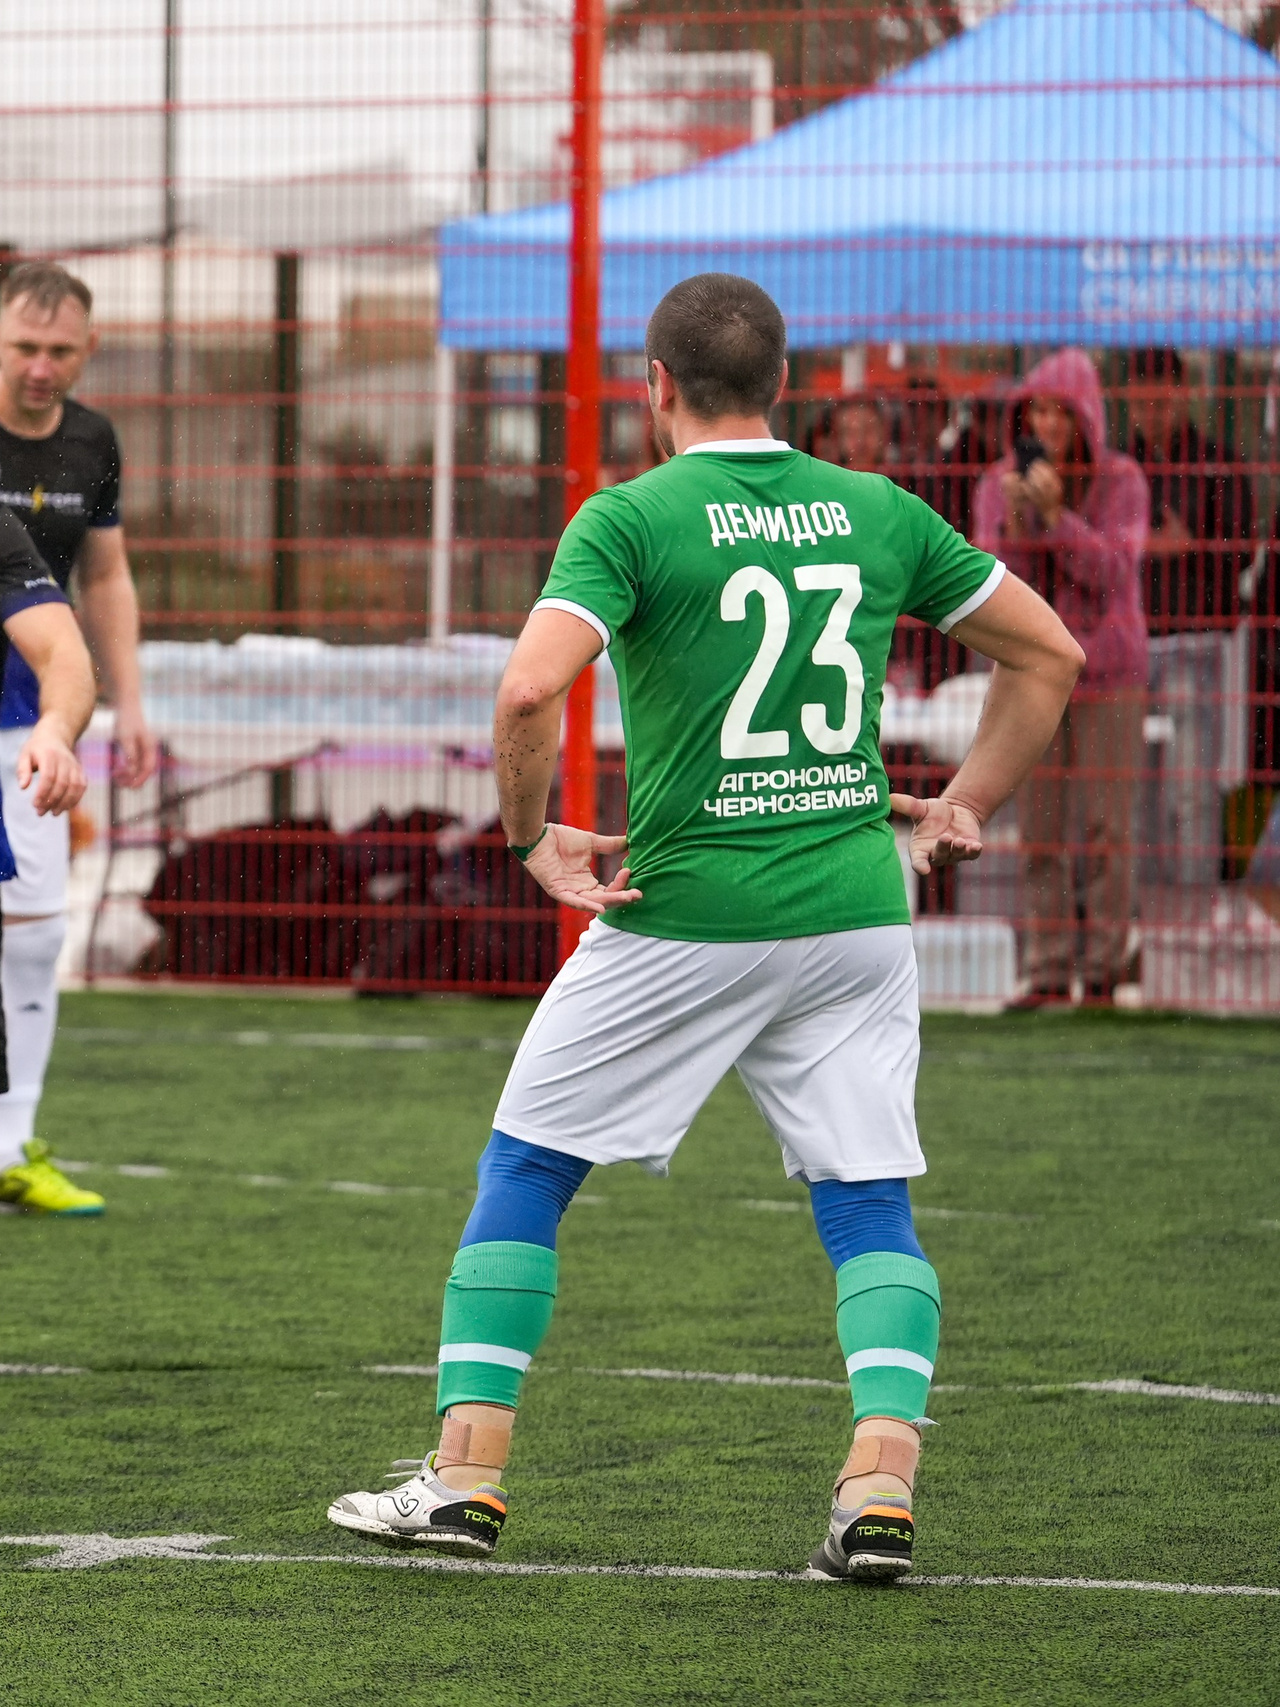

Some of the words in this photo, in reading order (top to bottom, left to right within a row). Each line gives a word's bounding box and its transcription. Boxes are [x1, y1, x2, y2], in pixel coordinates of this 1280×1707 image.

[705, 501, 852, 547] ДЕМИДОВ
[720, 563, 865, 759] 23
[718, 762, 867, 792] АГРОНОМЫ
[703, 784, 879, 817] ЧЕРНОЗЕМЬЯ
[463, 1509, 502, 1533] TOP-F
[856, 1526, 913, 1542] TOP-FLE
